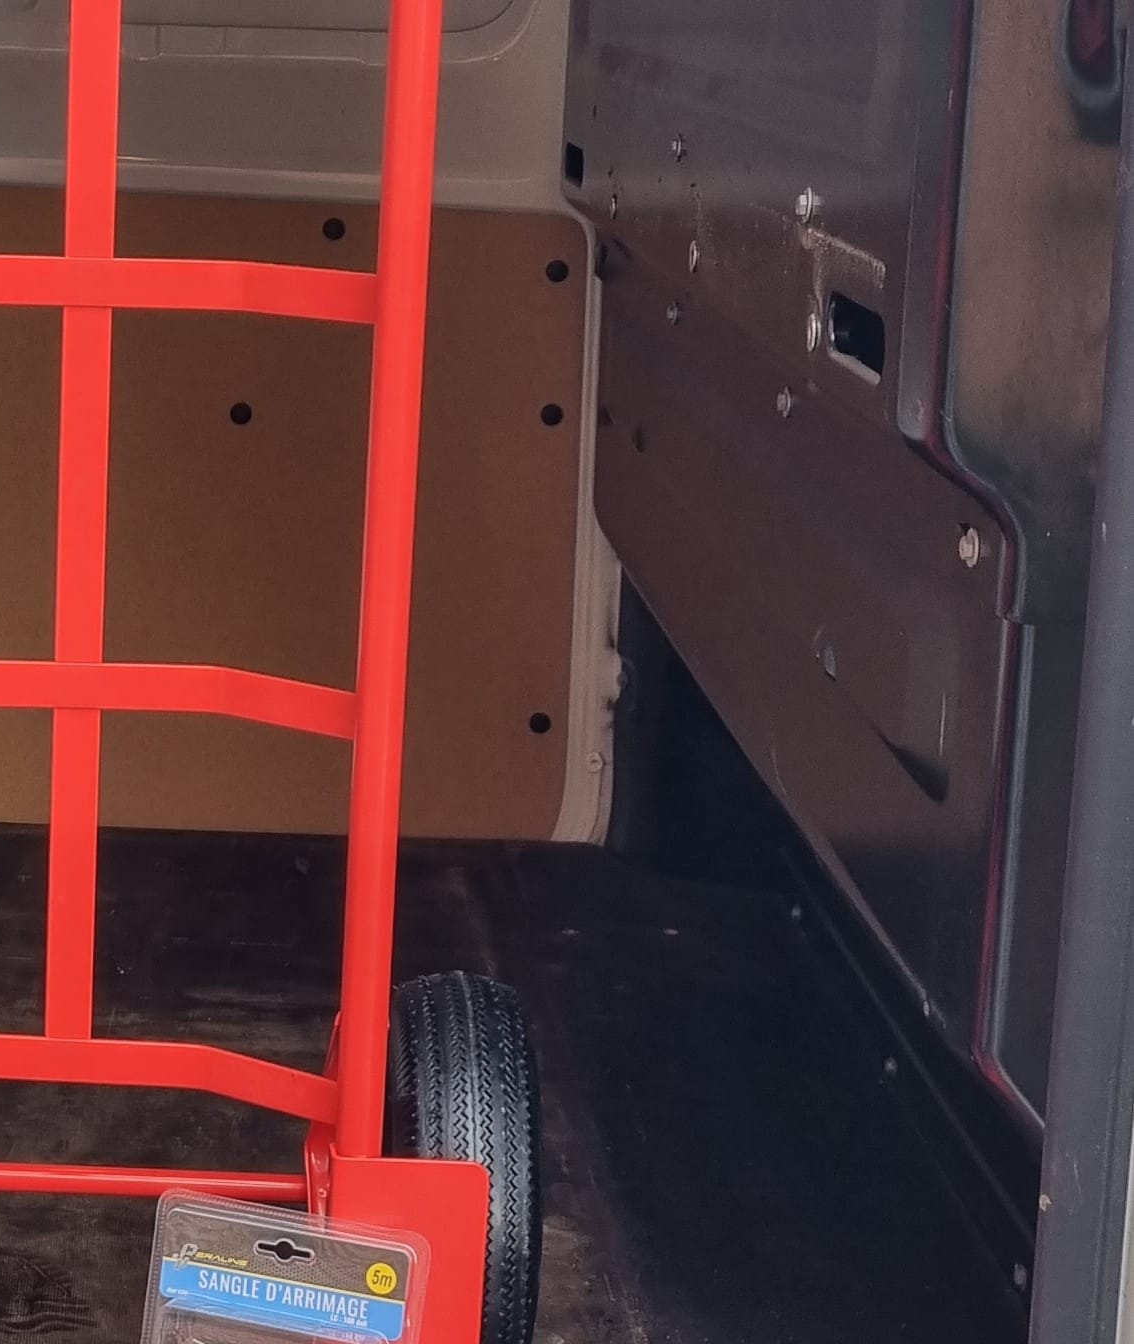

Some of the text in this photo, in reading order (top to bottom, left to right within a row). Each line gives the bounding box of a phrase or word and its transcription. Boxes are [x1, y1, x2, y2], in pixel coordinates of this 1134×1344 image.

[174, 1243, 249, 1268] PERALINE
[372, 1270, 392, 1287] 5m
[199, 1270, 370, 1319] SANGLE D'ARRIMAGE
